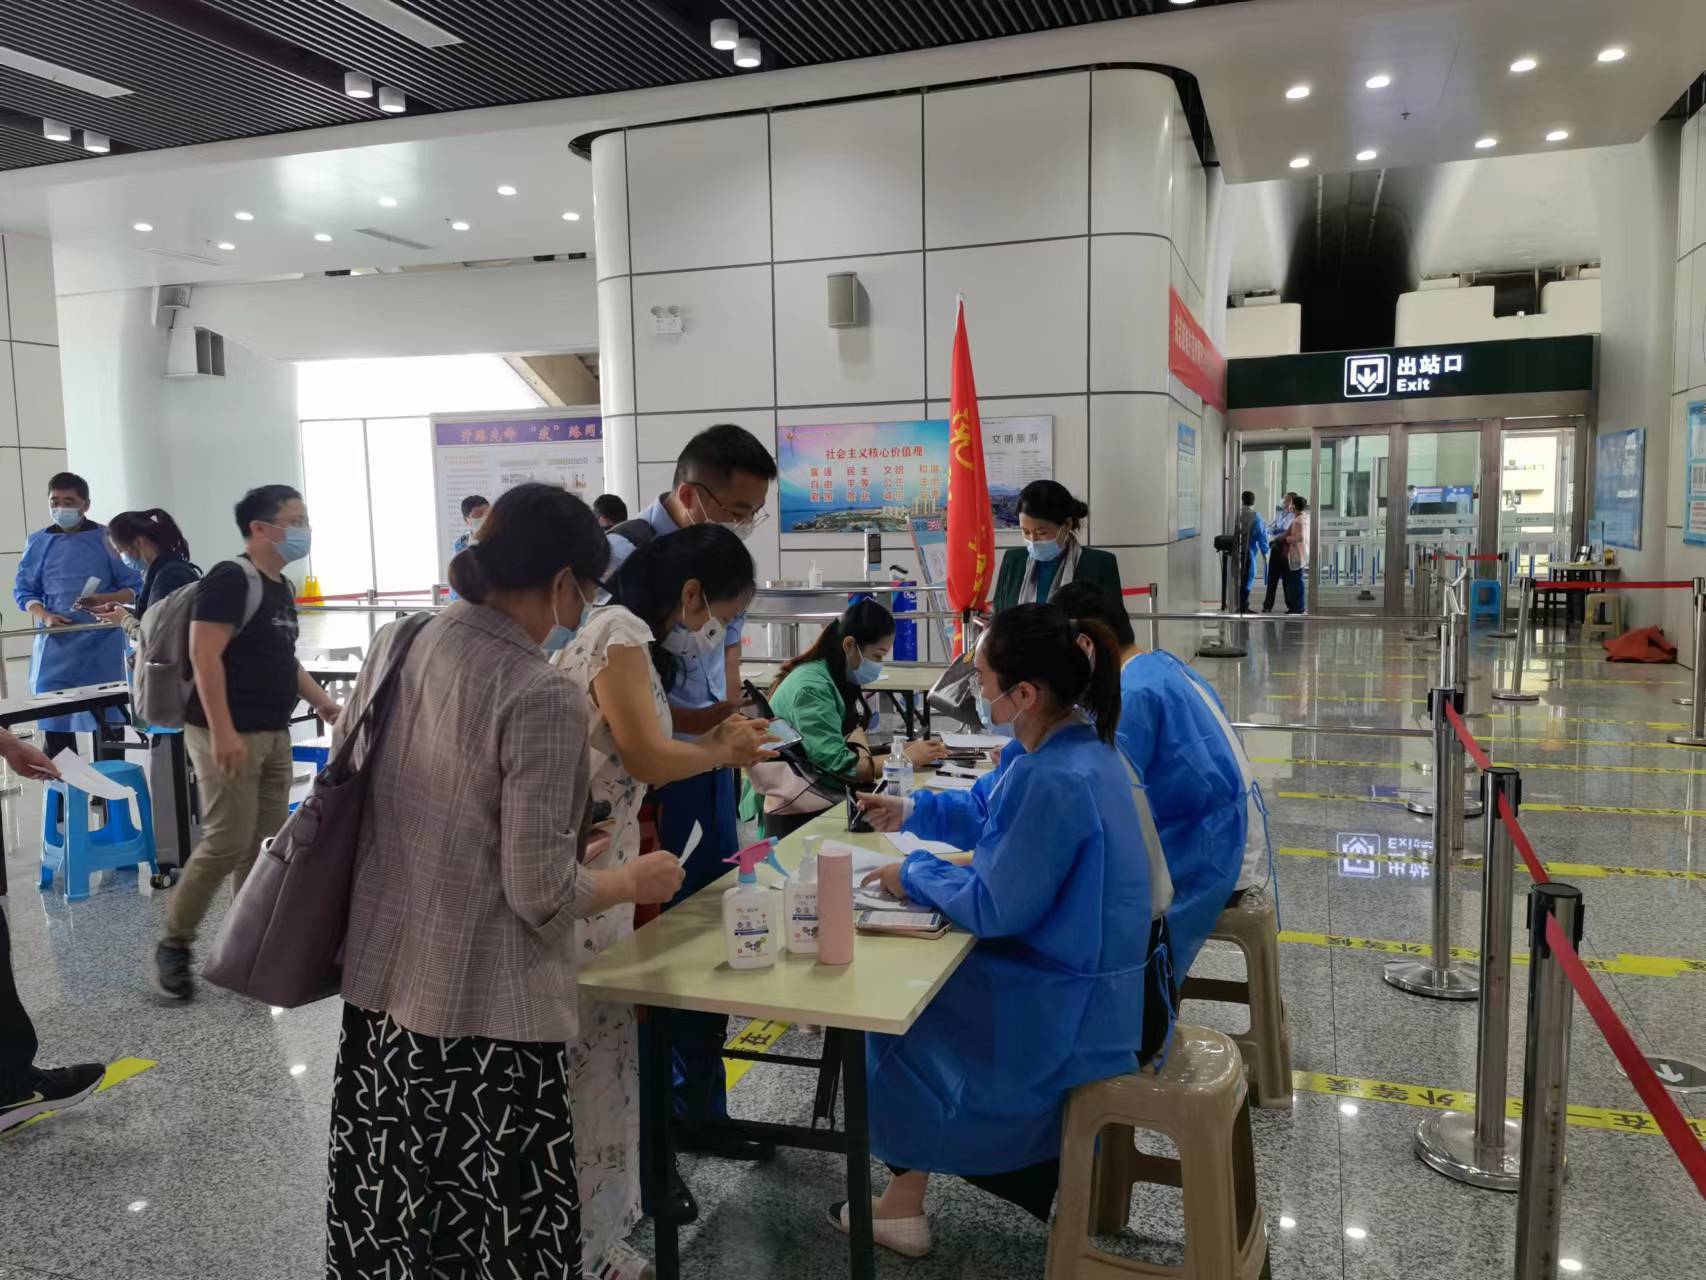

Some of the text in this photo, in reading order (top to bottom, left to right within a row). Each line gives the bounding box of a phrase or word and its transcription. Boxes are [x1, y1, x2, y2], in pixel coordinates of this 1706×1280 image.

[1397, 354, 1462, 376] 出站口
[1396, 378, 1430, 392] Exit
[826, 446, 924, 460] 社会主义核心价值观
